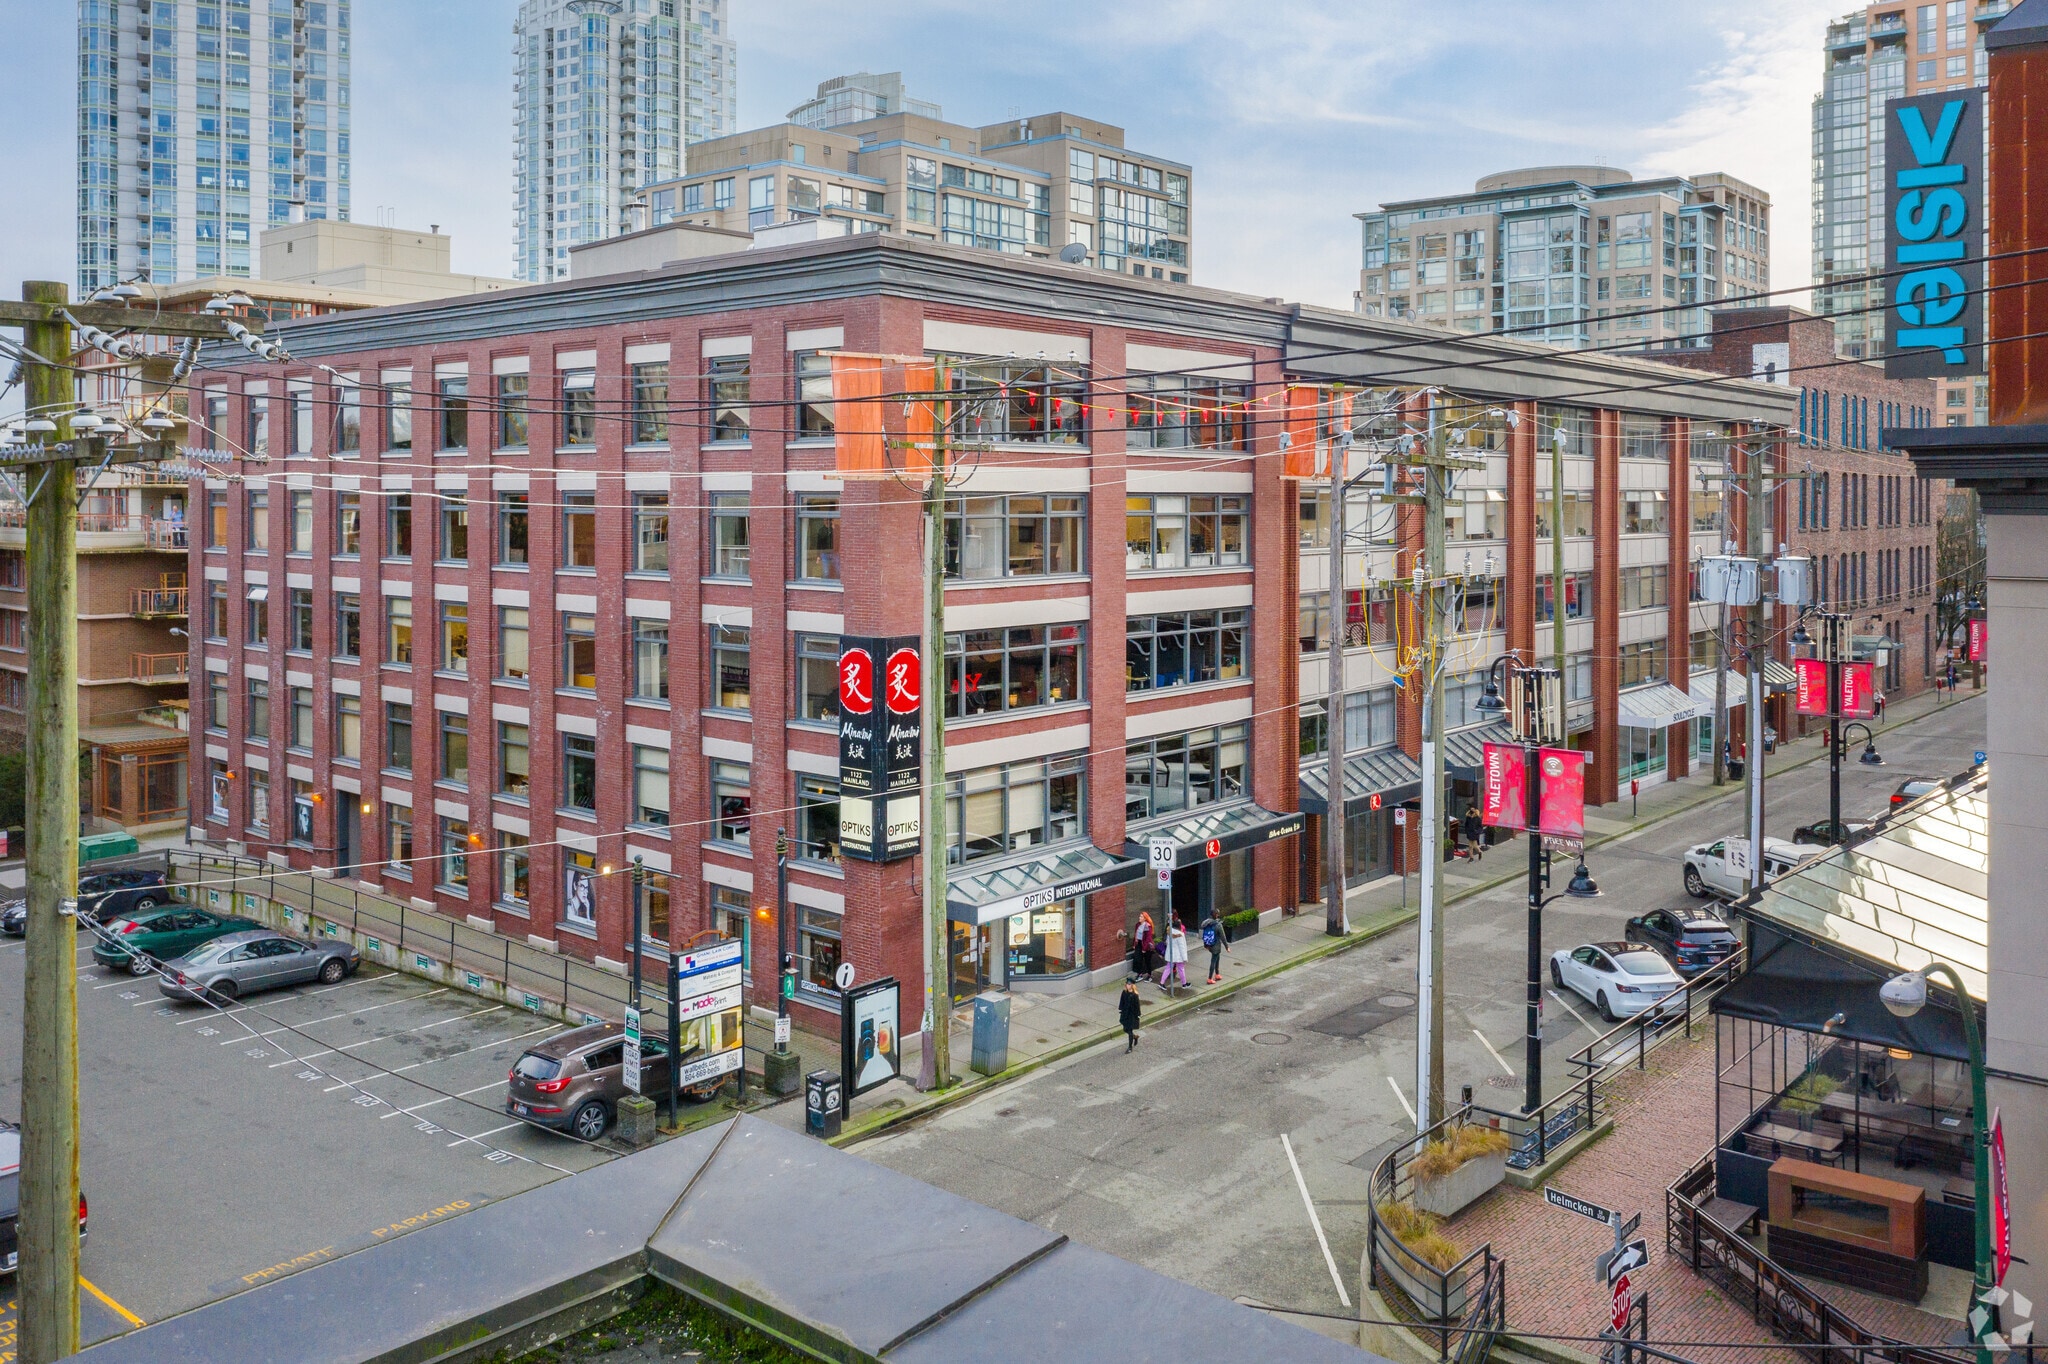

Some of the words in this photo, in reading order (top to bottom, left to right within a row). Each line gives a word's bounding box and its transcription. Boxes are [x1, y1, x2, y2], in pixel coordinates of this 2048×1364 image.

[1798, 664, 1808, 704] YALETOWN
[1844, 667, 1853, 707] YALETOWN
[1673, 708, 1695, 722] SOULCYCLE
[850, 771, 863, 779] 1122
[898, 772, 910, 780] 1122
[1489, 751, 1501, 809] YALETOWN
[843, 777, 869, 787] MAINLAND
[890, 777, 917, 787] MAINLAND
[842, 821, 871, 836] OPTIKS
[888, 821, 918, 836] OPTIKS
[841, 840, 871, 852] INTERNATIONAL
[888, 840, 919, 852] INTERNATIONAL
[1544, 836, 1565, 847] FREE
[1153, 846, 1172, 861] 30
[1023, 889, 1052, 908] OPTIKS
[1056, 878, 1102, 898] INTERNATIONAL
[625, 1048, 638, 1060] LOAD
[625, 1059, 638, 1070] LIMIT
[684, 1058, 720, 1074] wallbeds.com
[295, 1070, 322, 1081] 104
[350, 1094, 380, 1107] 103
[414, 1122, 444, 1135] 102
[483, 1150, 513, 1163] 101
[1550, 1192, 1594, 1217] Helmcken
[371, 1200, 471, 1238] PARKING
[1612, 1287, 1631, 1320] STOP
